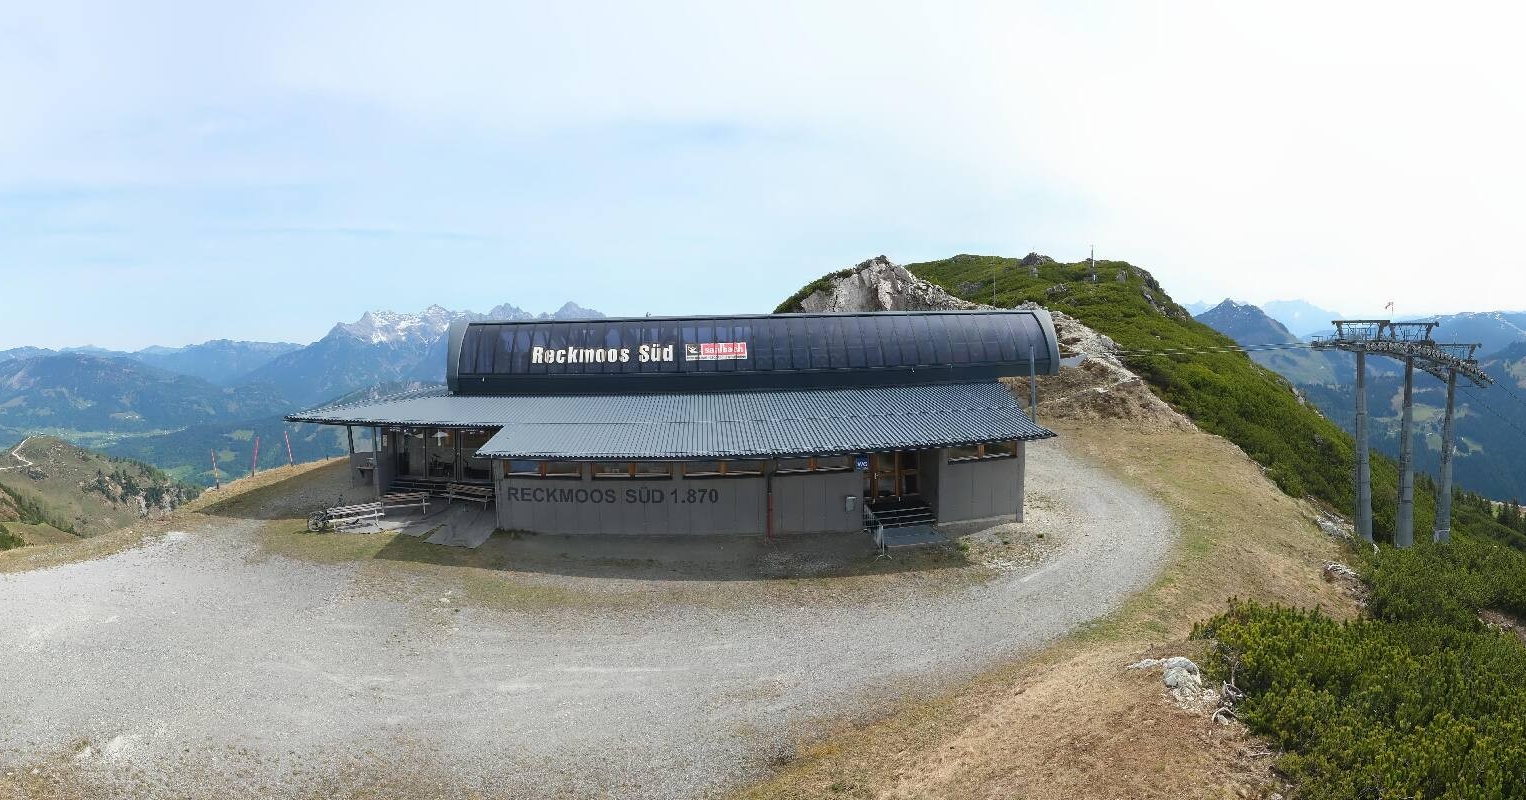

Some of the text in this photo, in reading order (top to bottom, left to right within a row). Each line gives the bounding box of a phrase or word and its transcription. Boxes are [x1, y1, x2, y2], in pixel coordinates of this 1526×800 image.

[532, 342, 674, 364] Reckmoos Süd
[507, 486, 718, 504] RECKMOOS SÜD 1.870
